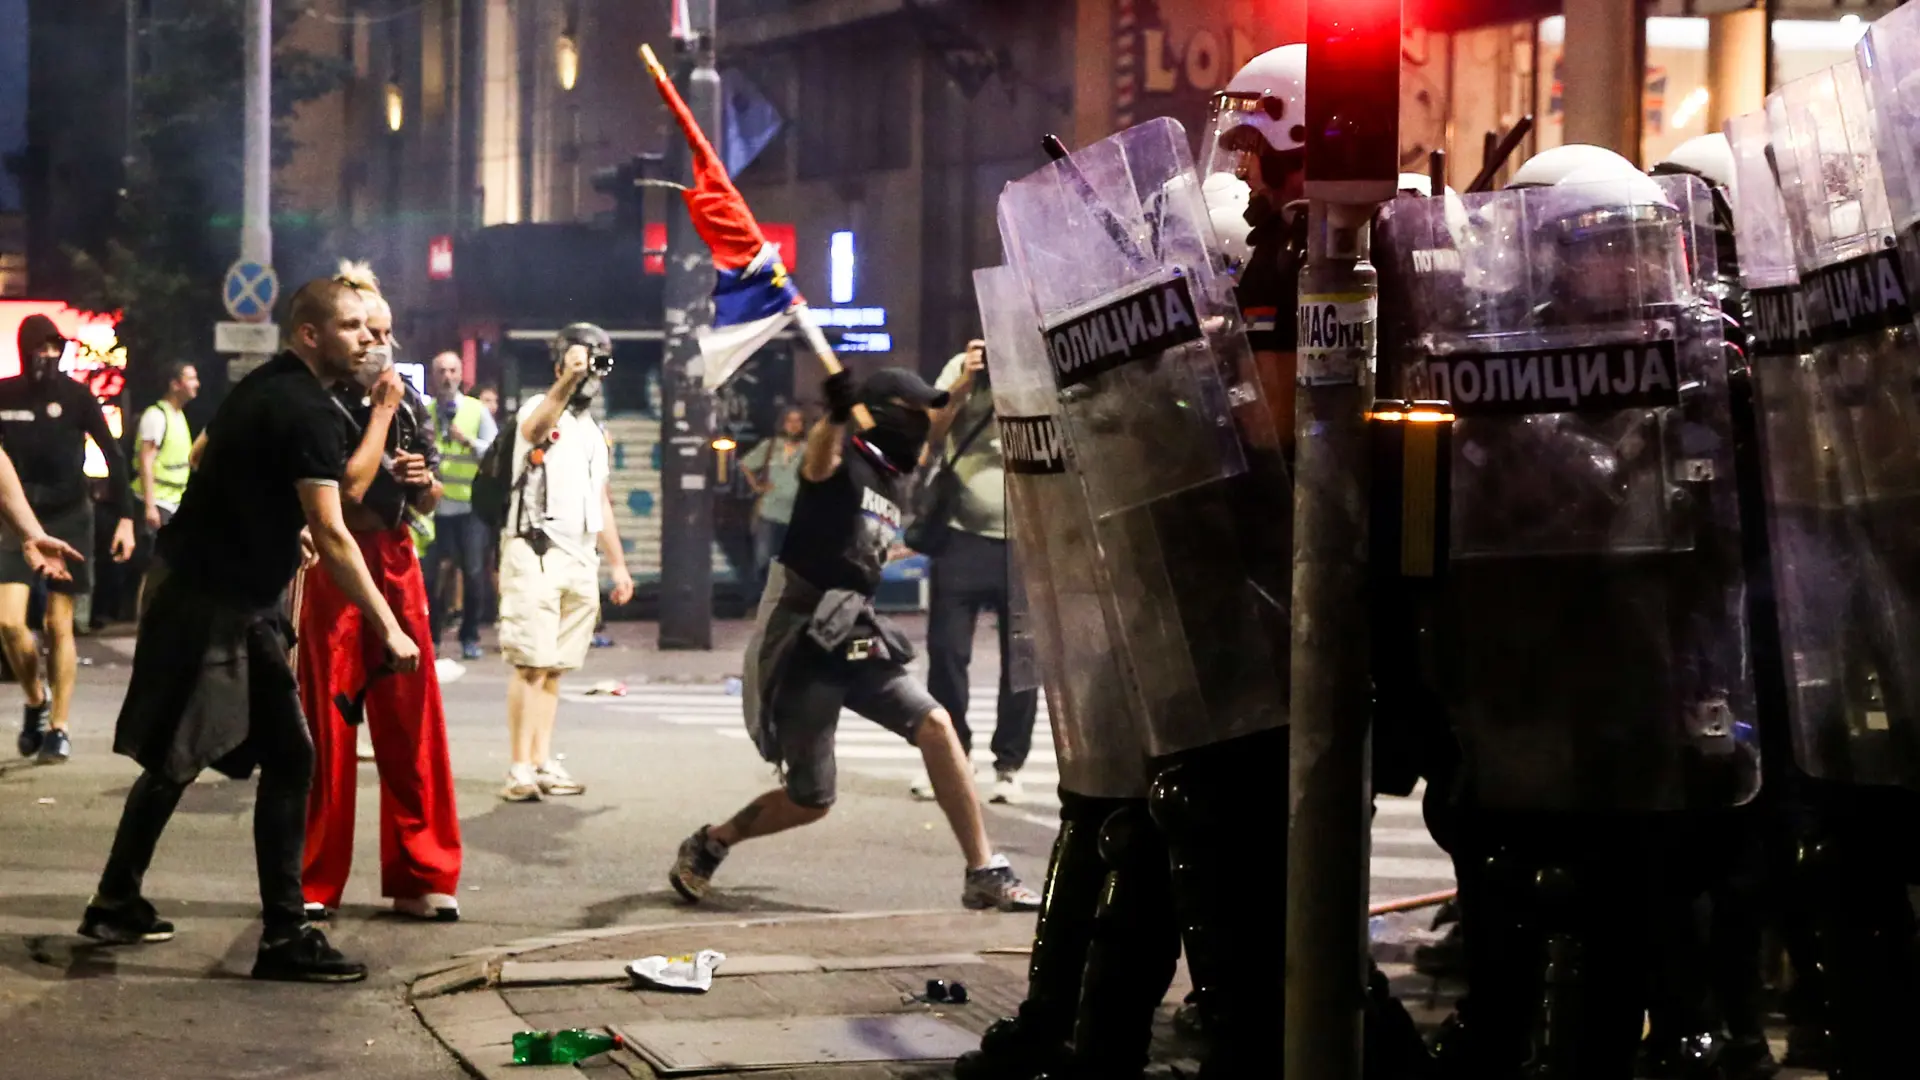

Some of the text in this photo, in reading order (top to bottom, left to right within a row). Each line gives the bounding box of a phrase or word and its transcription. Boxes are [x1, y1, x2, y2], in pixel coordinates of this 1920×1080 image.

[1050, 287, 1193, 375] ОЛИЦИЈА
[1428, 348, 1672, 405] ПОЛИЦИЈА
[1001, 420, 1063, 468] ОЛИЦИ
